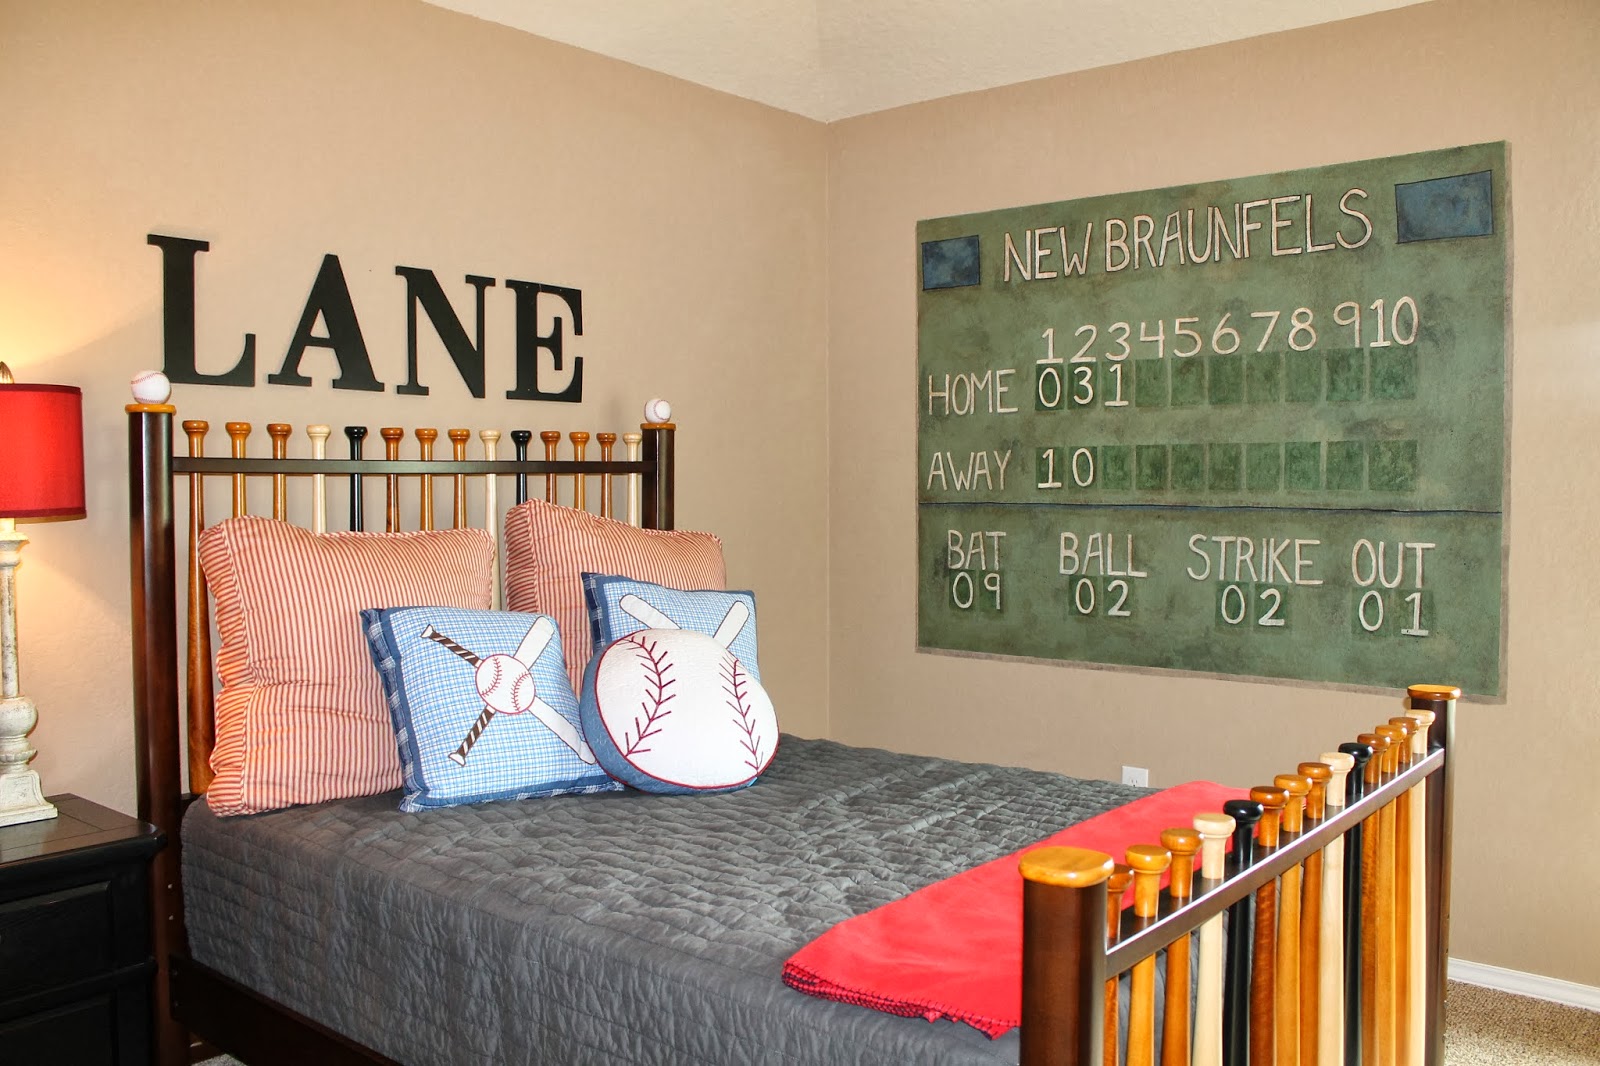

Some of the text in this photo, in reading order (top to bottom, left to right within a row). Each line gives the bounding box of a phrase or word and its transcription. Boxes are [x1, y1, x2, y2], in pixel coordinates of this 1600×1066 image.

[1003, 186, 1373, 283] NEW BRAUNFELS
[147, 233, 583, 403] LANE
[928, 368, 1020, 416] HOME
[926, 449, 1012, 492] AWAY
[947, 529, 1007, 571] BAT
[1059, 531, 1148, 578] BALL
[1186, 534, 1324, 586] STRIKE
[1351, 538, 1436, 589] OUT
